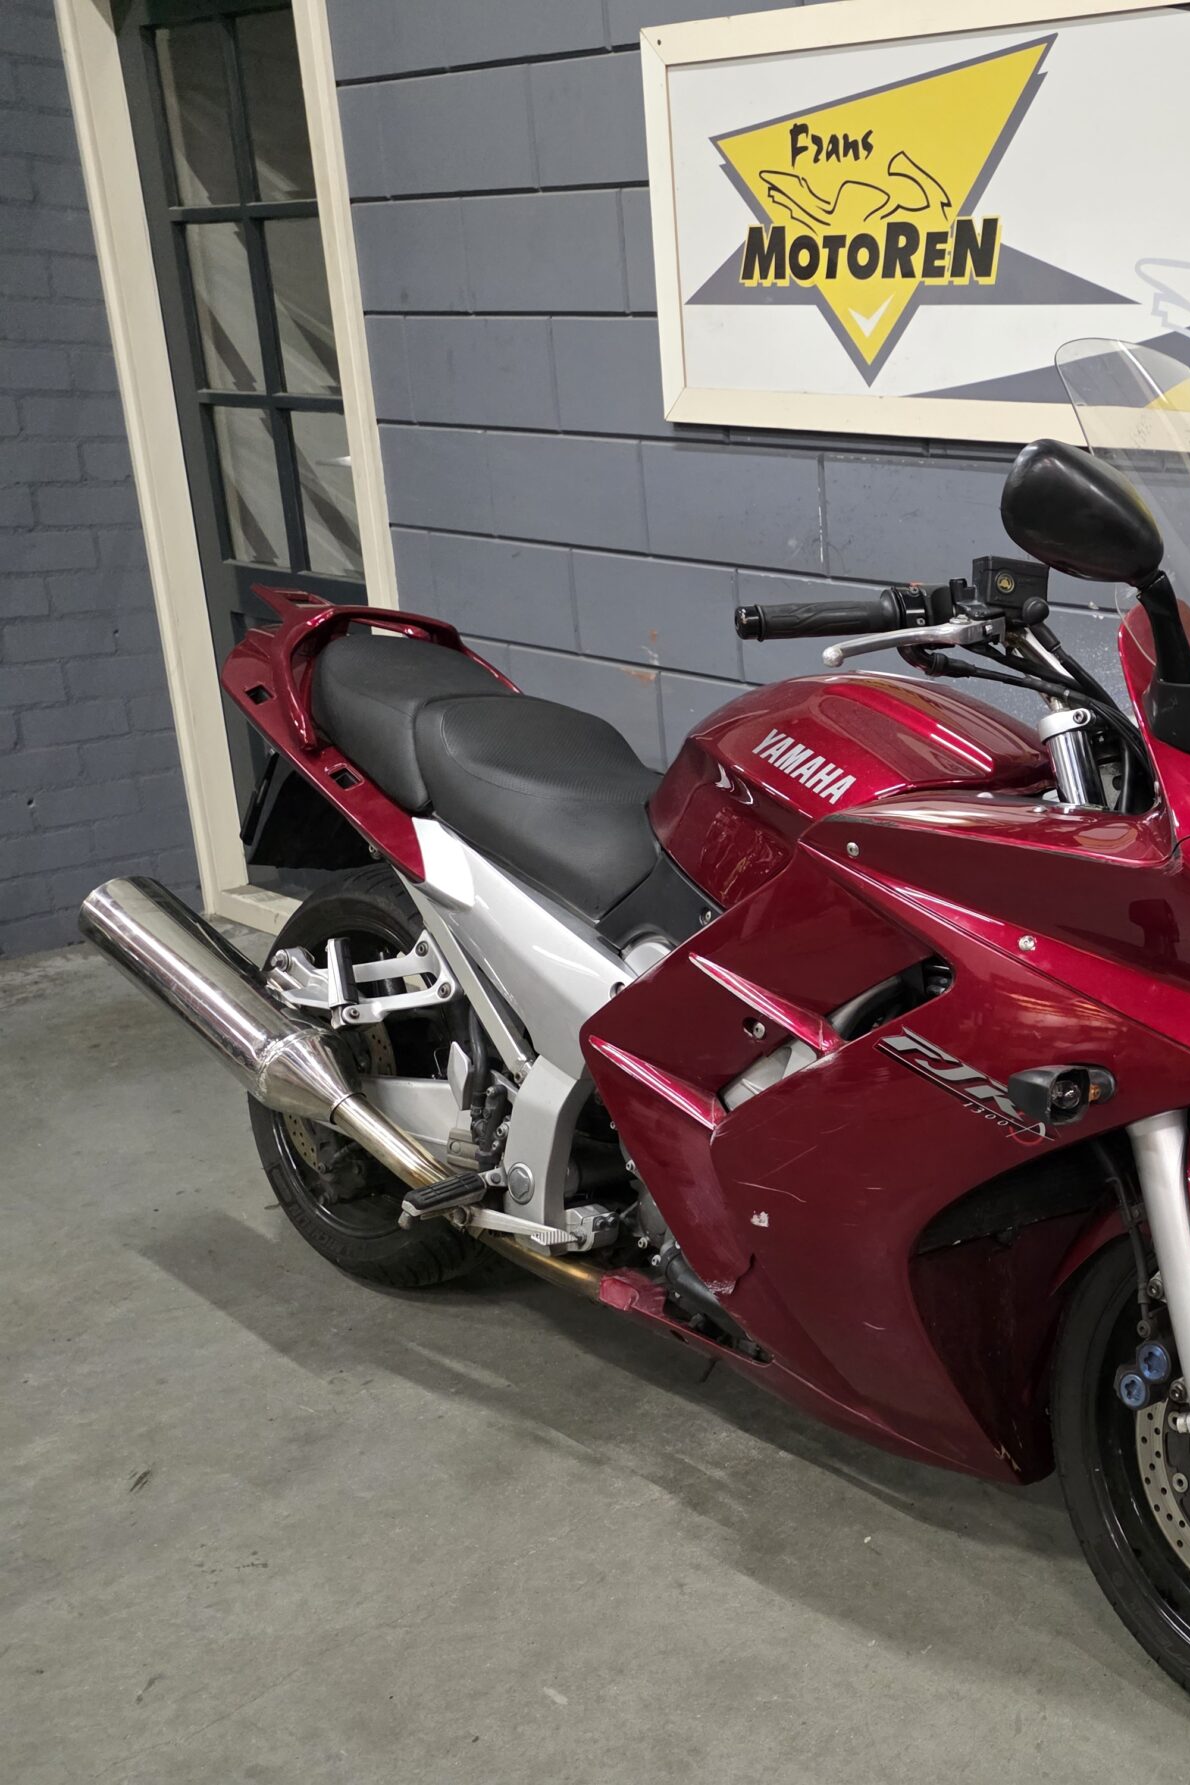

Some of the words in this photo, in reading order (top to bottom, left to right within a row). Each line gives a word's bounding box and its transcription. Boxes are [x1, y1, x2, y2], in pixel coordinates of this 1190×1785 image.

[789, 123, 874, 168] Frans
[752, 728, 857, 805] YAMAHA
[962, 1102, 1010, 1127] 1300
